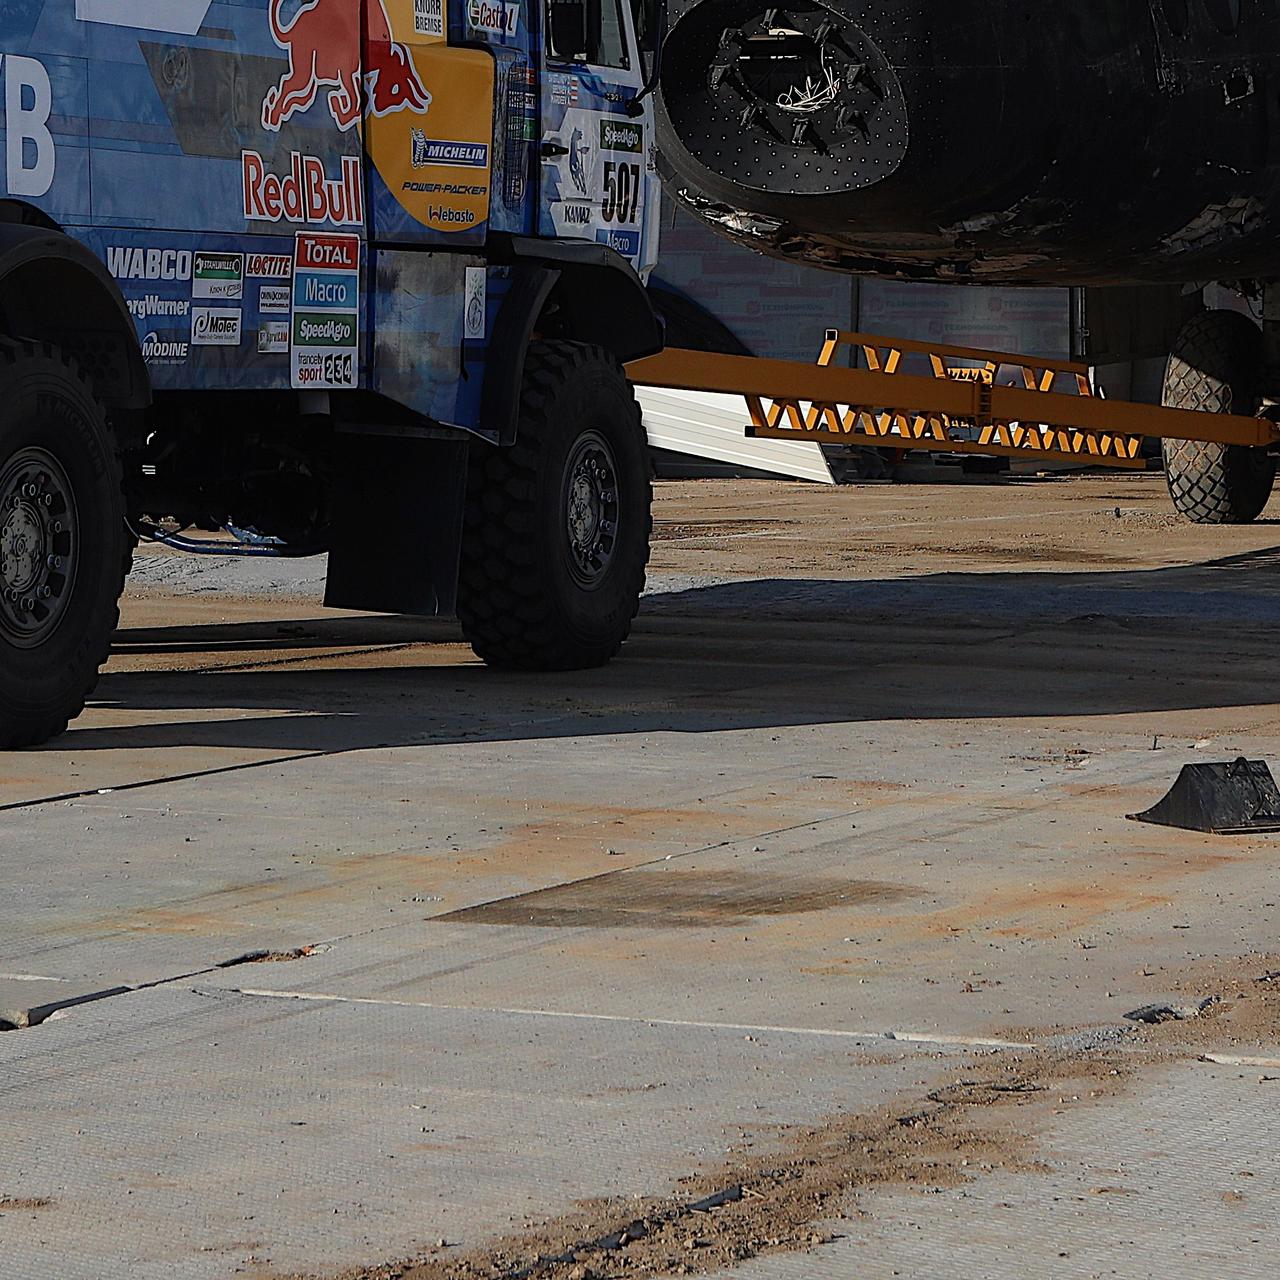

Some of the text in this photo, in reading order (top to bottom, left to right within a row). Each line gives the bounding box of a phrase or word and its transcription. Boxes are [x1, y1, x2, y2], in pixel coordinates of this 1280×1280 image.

[415, 16, 442, 33] BREMSE
[604, 126, 639, 148] SpeedAgro
[427, 145, 486, 160] MICHELIN
[243, 153, 362, 222] Red Bull
[401, 181, 488, 196] POWER-PACKER
[601, 160, 639, 224] 507
[428, 205, 476, 223] Webasto
[564, 206, 591, 224] KAMAZ
[606, 234, 630, 251] Macro
[106, 247, 191, 281] WABCO
[246, 255, 290, 276] LOCTITE
[305, 277, 347, 303] Macro
[299, 319, 352, 342] SpeedAgro
[142, 342, 188, 357] MODINE
[298, 366, 323, 384] sport
